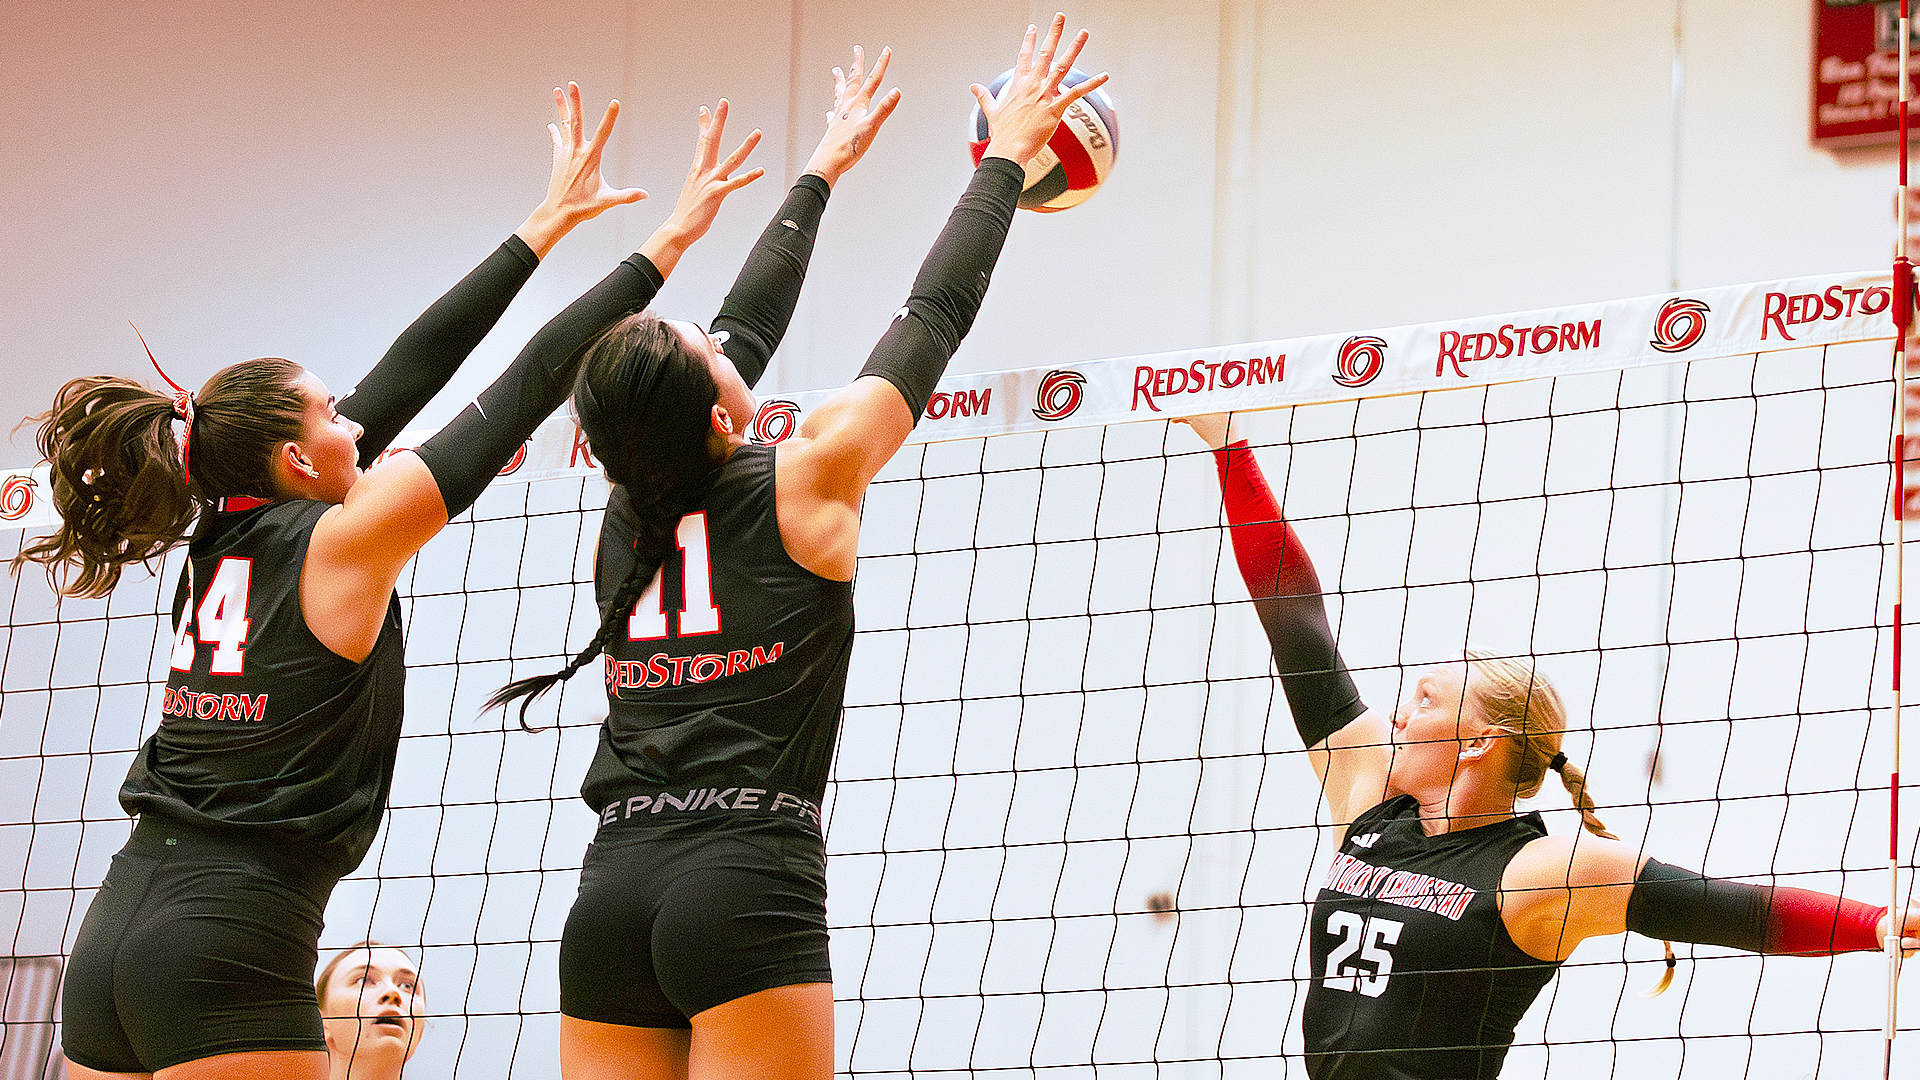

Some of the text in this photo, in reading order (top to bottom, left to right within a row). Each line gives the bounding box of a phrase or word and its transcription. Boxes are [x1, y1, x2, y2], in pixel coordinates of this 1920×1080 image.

[1066, 102, 1107, 150] Bade
[1760, 284, 1894, 341] REDSTO
[651, 788, 767, 813] NIKE
[1323, 910, 1405, 998] 25
